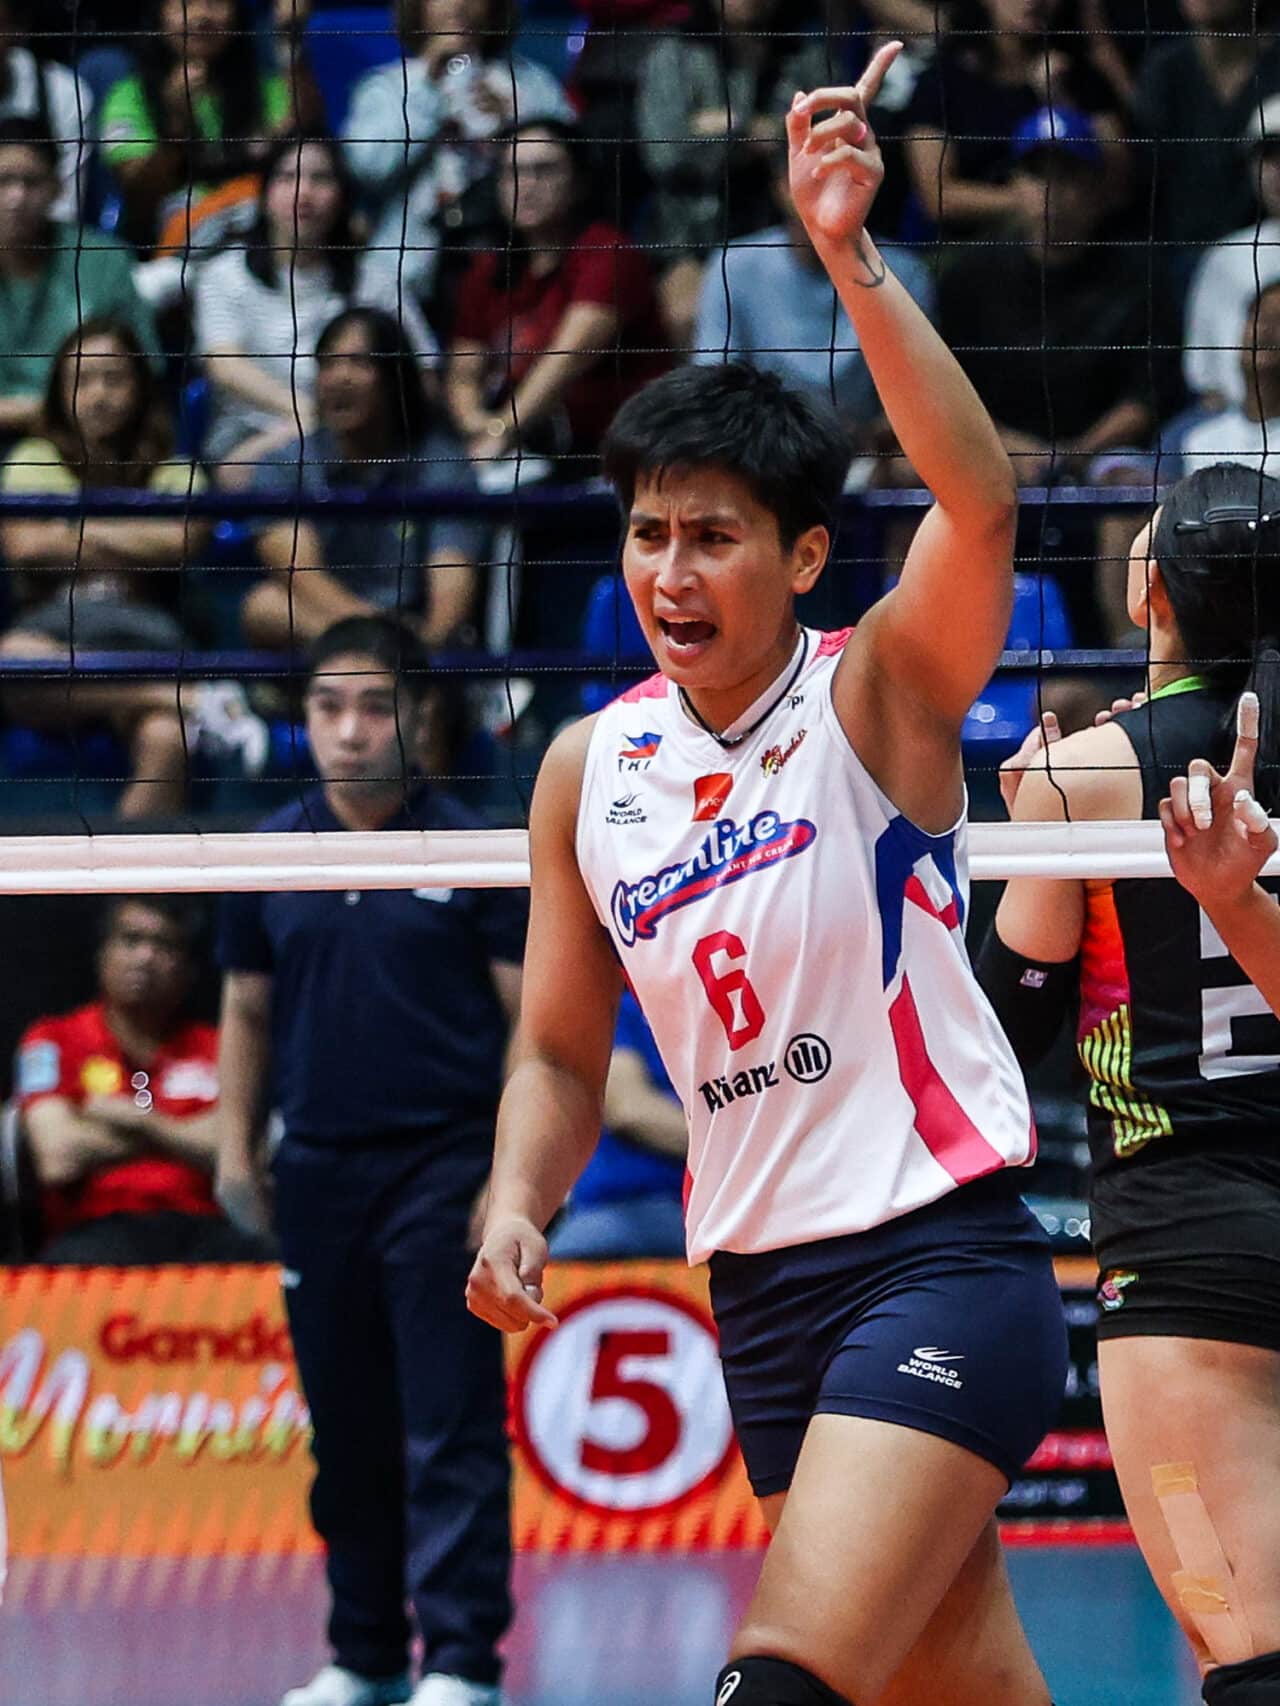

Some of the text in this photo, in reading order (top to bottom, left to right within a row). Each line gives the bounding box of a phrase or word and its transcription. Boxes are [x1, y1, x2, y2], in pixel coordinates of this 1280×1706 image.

[692, 930, 766, 1051] 6
[577, 1330, 683, 1476] 5
[896, 1363, 964, 1390] BALANCE
[908, 1357, 959, 1379] WORLD
